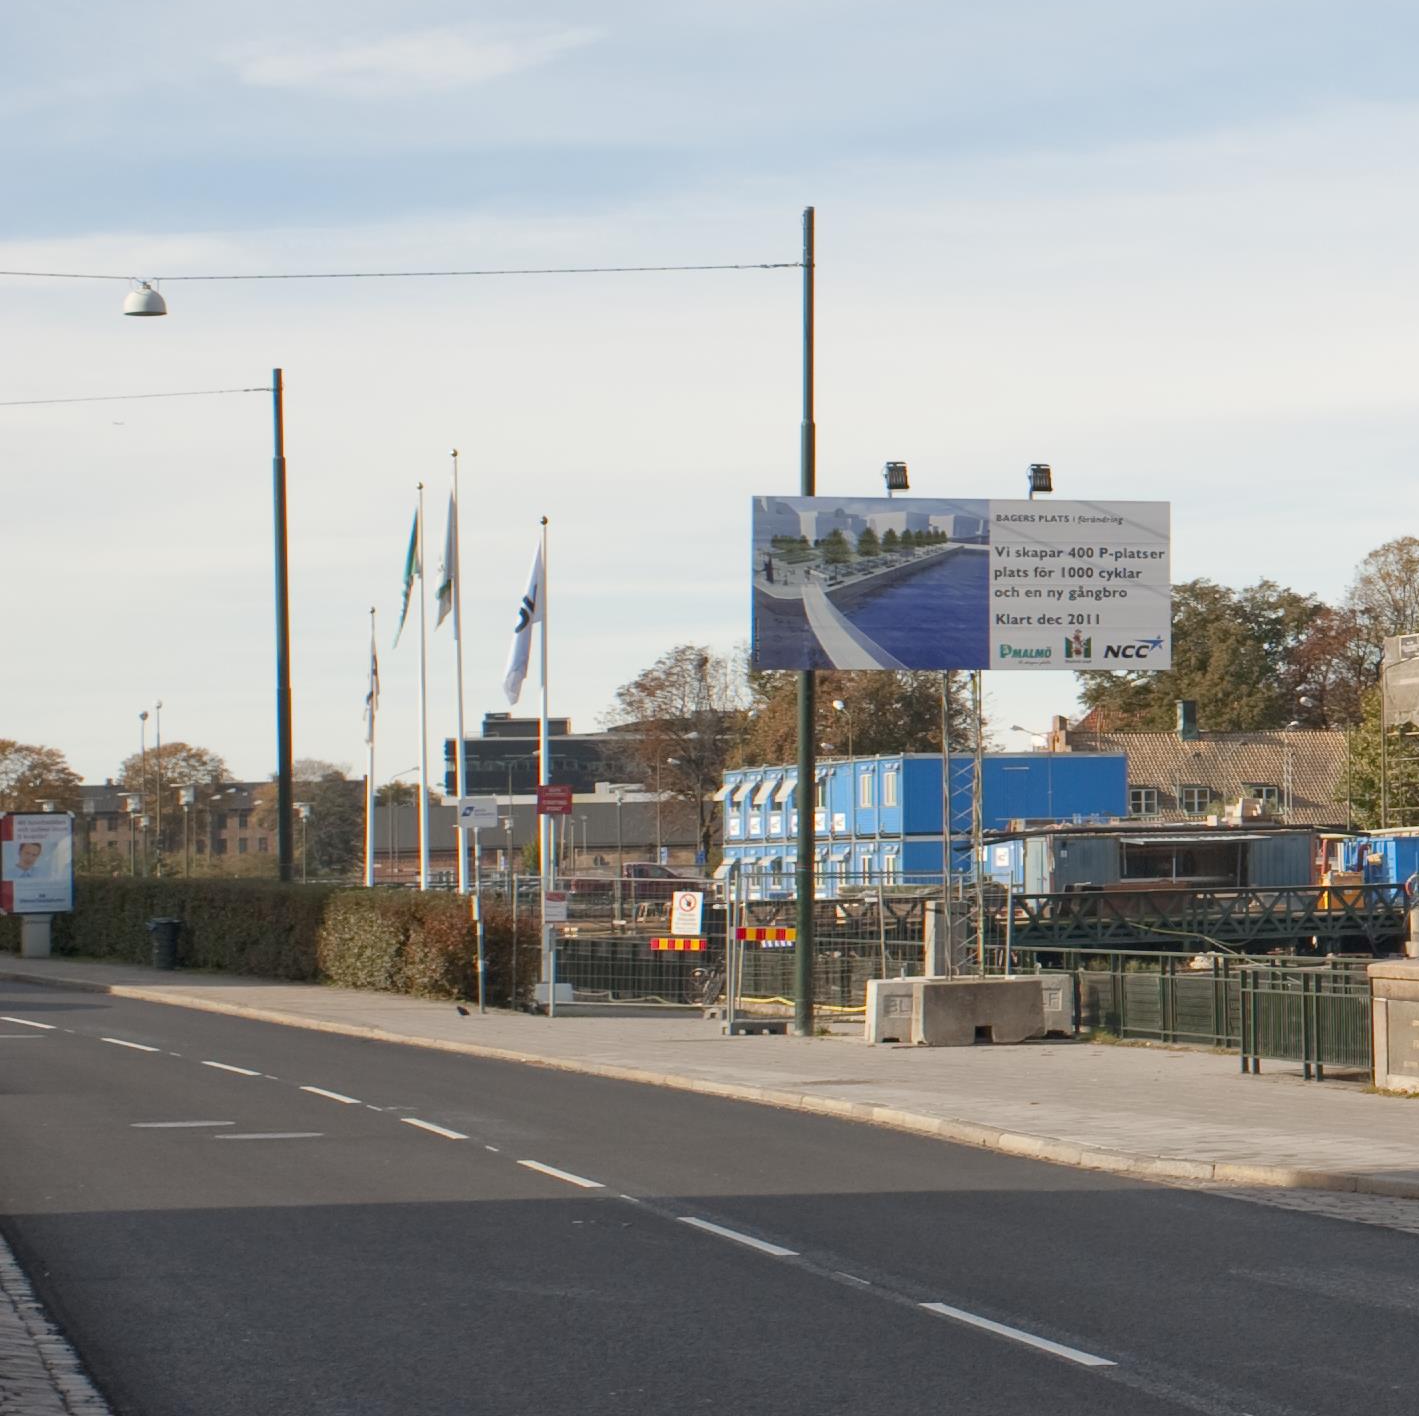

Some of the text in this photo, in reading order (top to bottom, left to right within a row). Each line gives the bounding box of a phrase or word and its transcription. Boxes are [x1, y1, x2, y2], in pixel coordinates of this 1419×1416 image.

[996, 514, 1036, 523] BAGERS
[1038, 515, 1070, 523] PLATS
[994, 546, 1166, 562] Vi skapar 400 P-platser
[994, 566, 1143, 583] plats för 1000 cyklar
[994, 585, 1128, 602] och en ny gångbro
[995, 613, 1101, 626] Klart dec 2011
[1103, 645, 1150, 659] NCC
